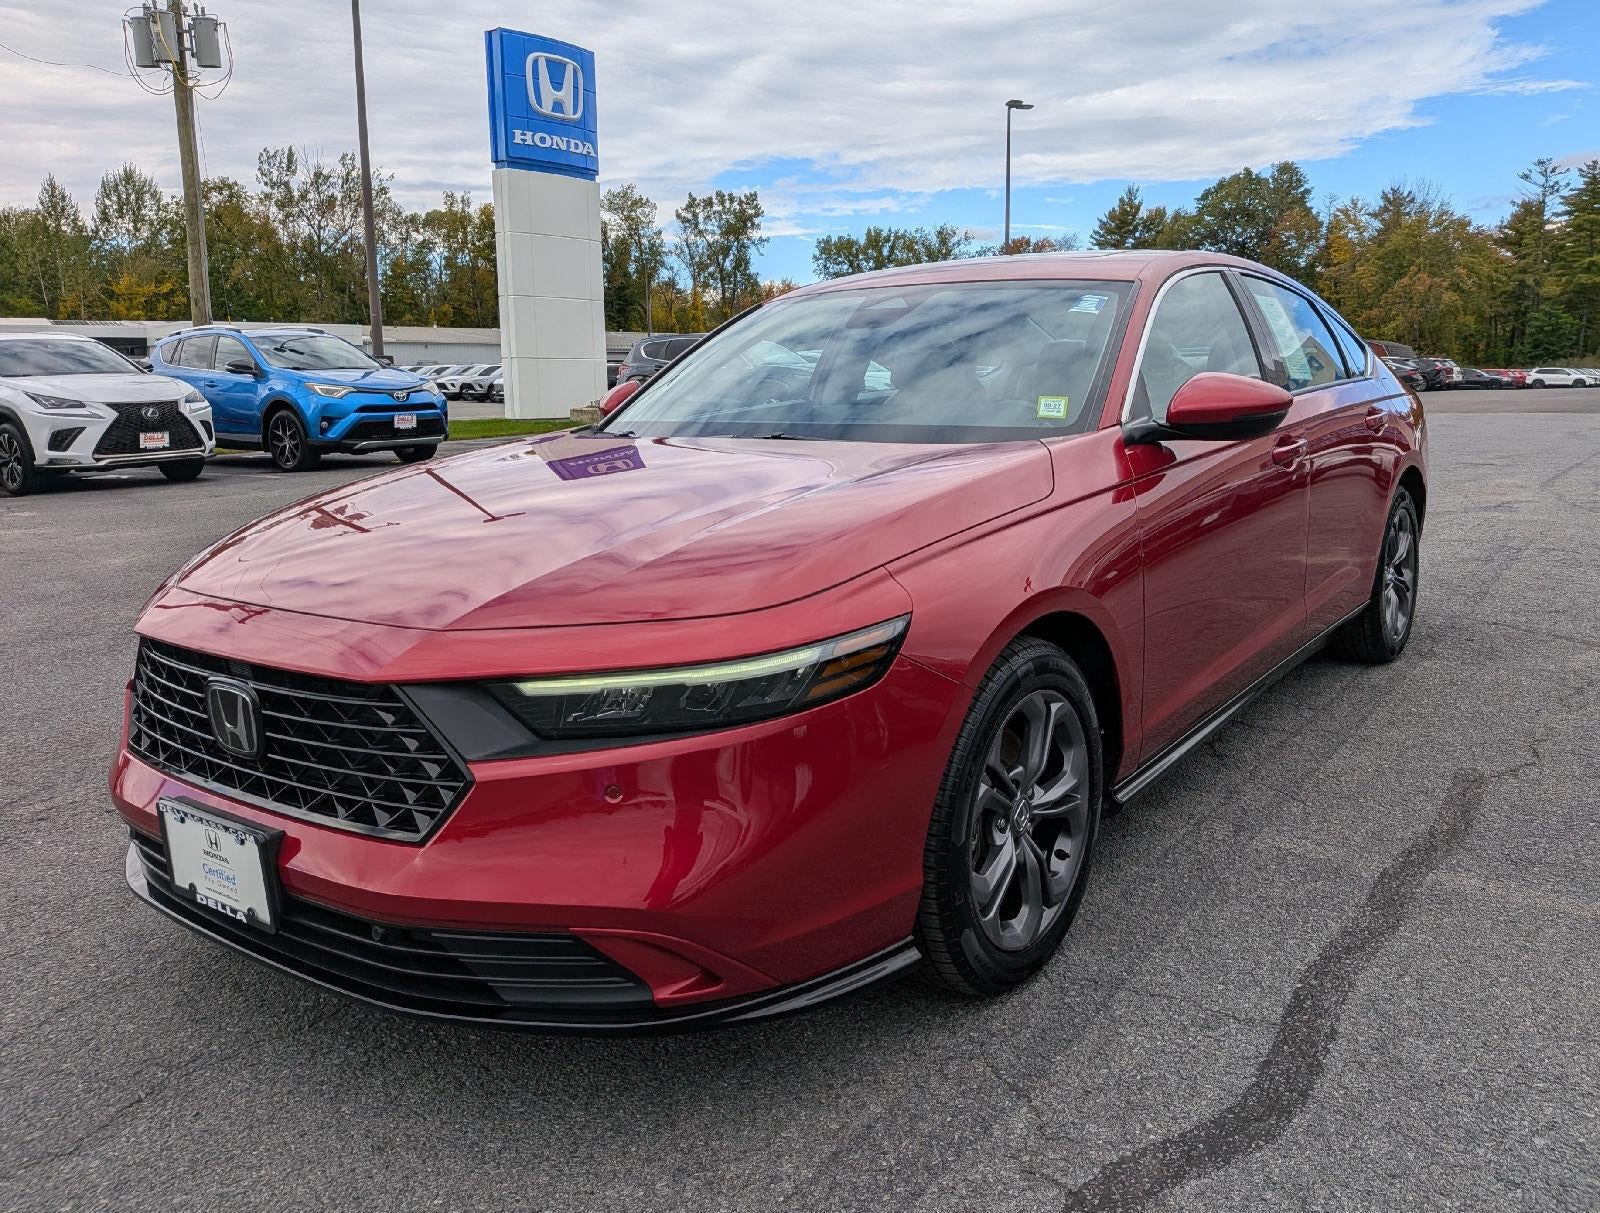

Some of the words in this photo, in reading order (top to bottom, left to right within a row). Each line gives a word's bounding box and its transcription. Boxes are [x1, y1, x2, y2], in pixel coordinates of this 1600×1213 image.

[512, 129, 597, 157] HONDA
[202, 848, 230, 865] HONDA
[202, 863, 236, 885] Certified
[196, 893, 248, 924] DELLA
